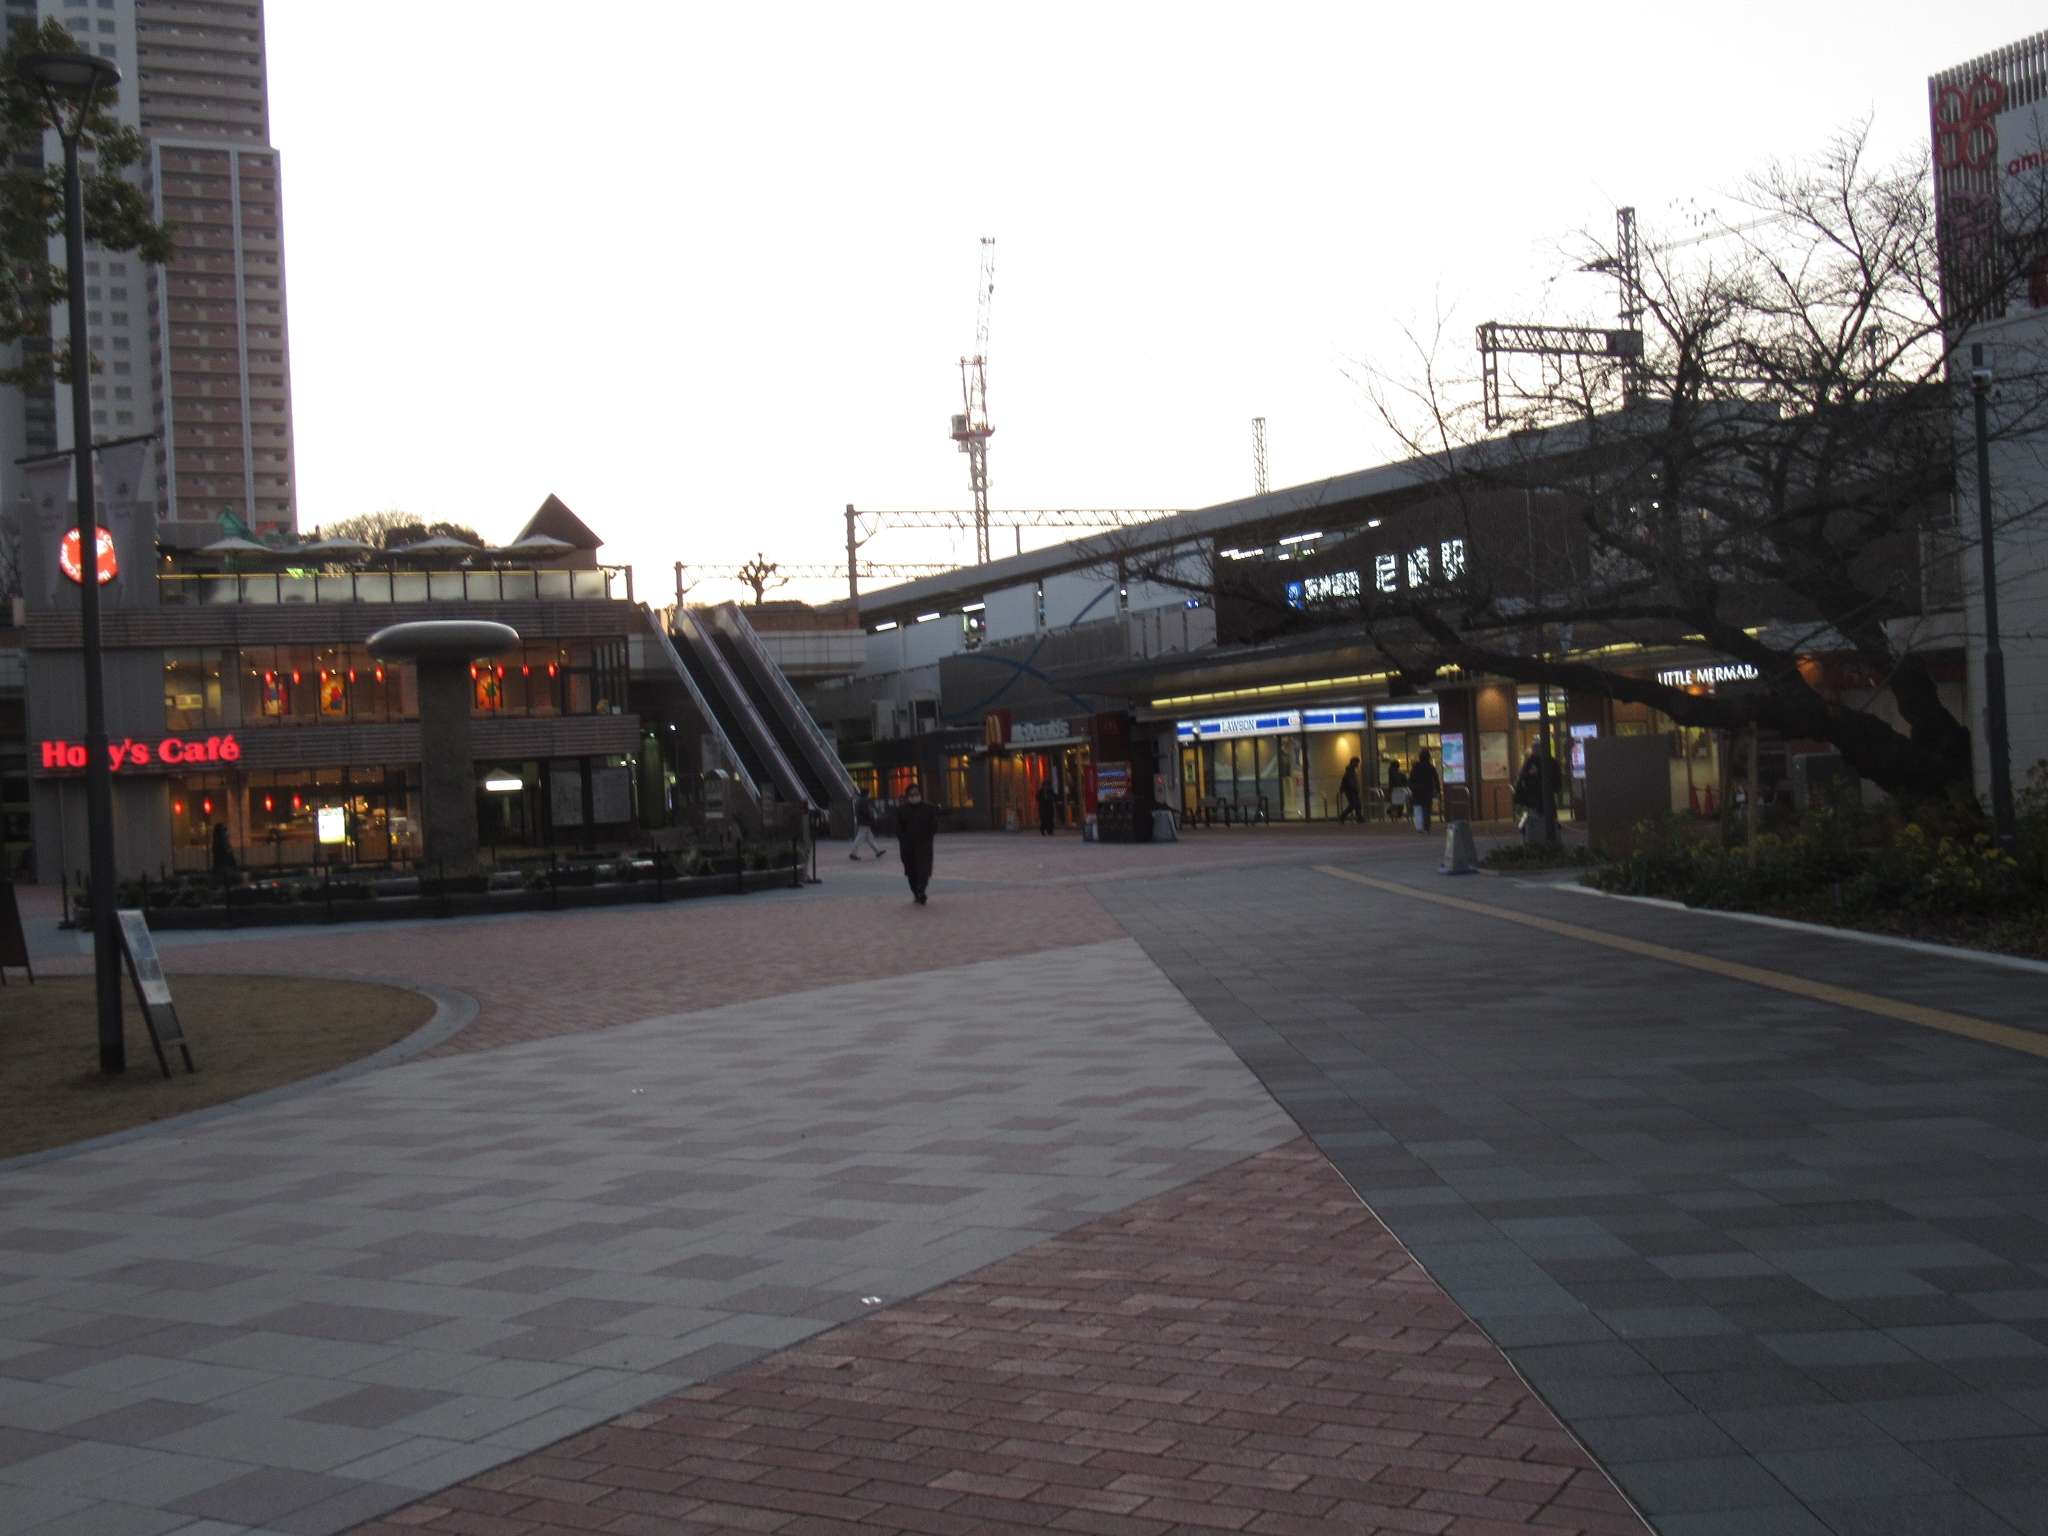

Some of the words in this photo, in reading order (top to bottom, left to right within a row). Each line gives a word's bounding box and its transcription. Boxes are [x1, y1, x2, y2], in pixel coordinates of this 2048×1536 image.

[1221, 719, 1256, 734] LAWSON
[41, 738, 150, 772] Hoy's
[158, 734, 241, 764] Café
